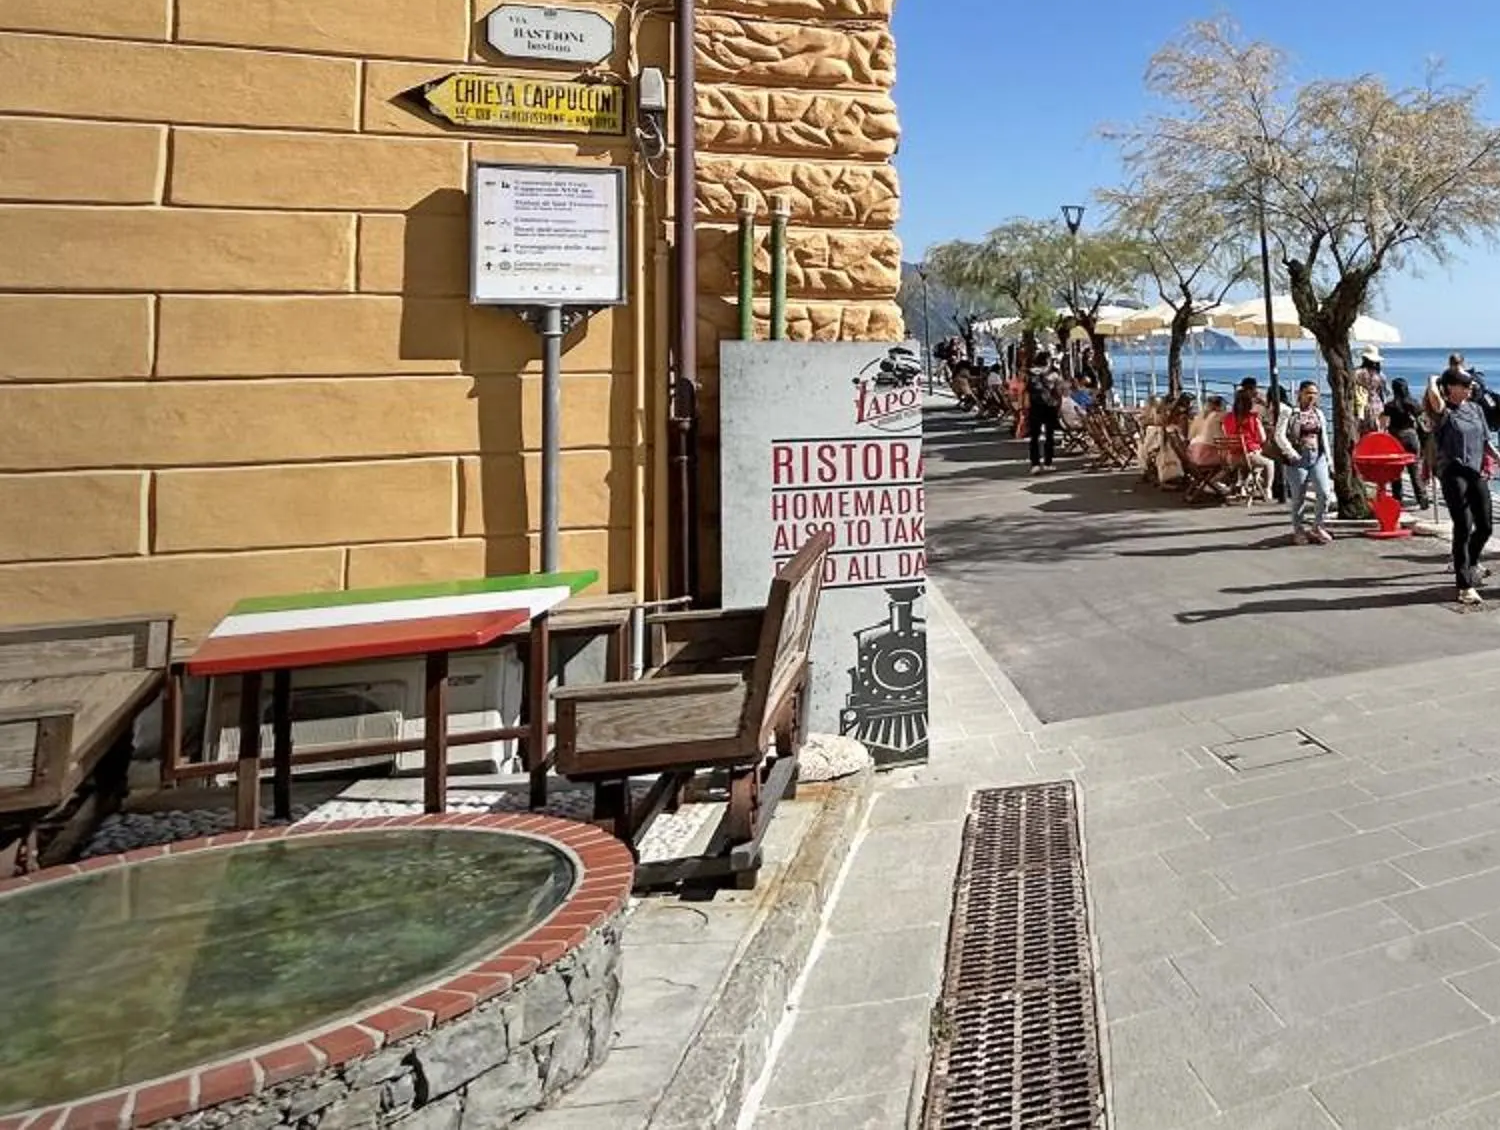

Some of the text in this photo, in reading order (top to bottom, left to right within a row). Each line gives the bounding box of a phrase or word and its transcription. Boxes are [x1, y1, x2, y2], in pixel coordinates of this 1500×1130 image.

[455, 78, 617, 114] CHIESA CAPPUCCINI
[773, 521, 836, 551] ALSO
[843, 519, 871, 547] TO
[847, 553, 886, 581] ALL
